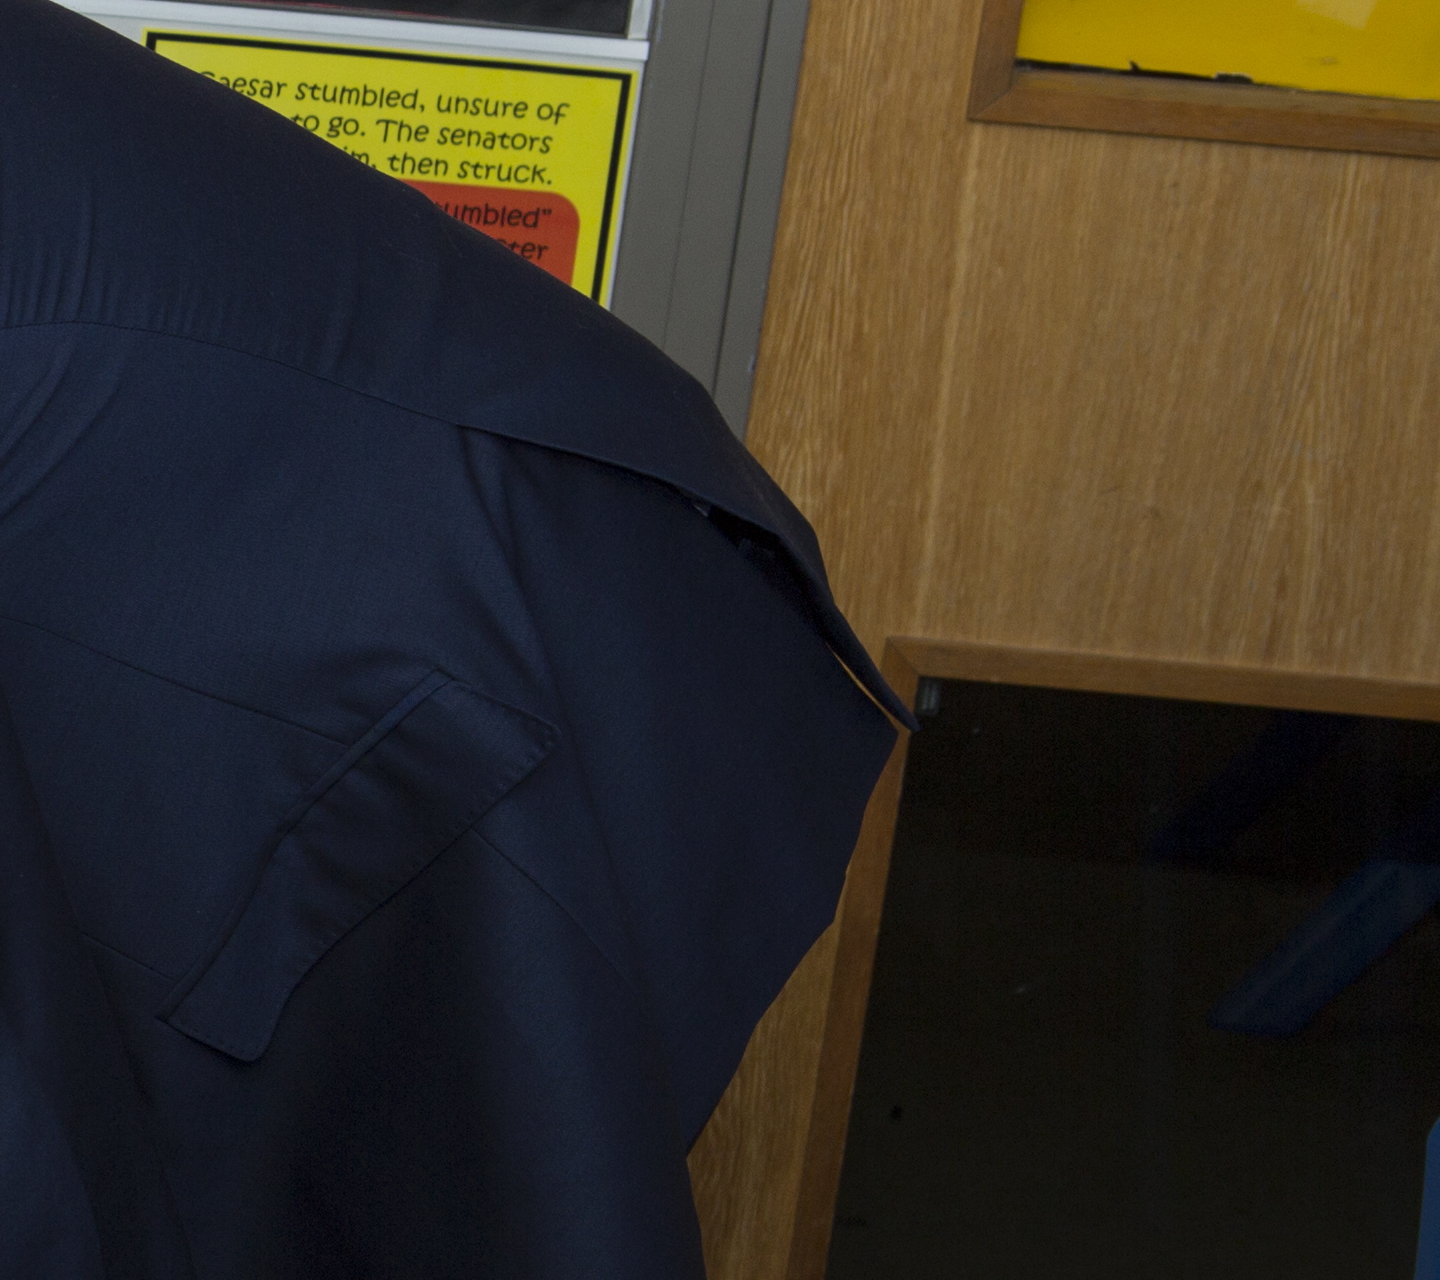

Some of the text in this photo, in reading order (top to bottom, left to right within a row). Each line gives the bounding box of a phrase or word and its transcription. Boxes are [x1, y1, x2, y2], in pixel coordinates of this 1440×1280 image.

[294, 82, 425, 113] stumbled,
[436, 94, 529, 119] unsure
[536, 102, 570, 125] of
[326, 116, 553, 154] go. The senators
[387, 153, 449, 176] then
[457, 160, 552, 185] struck.
